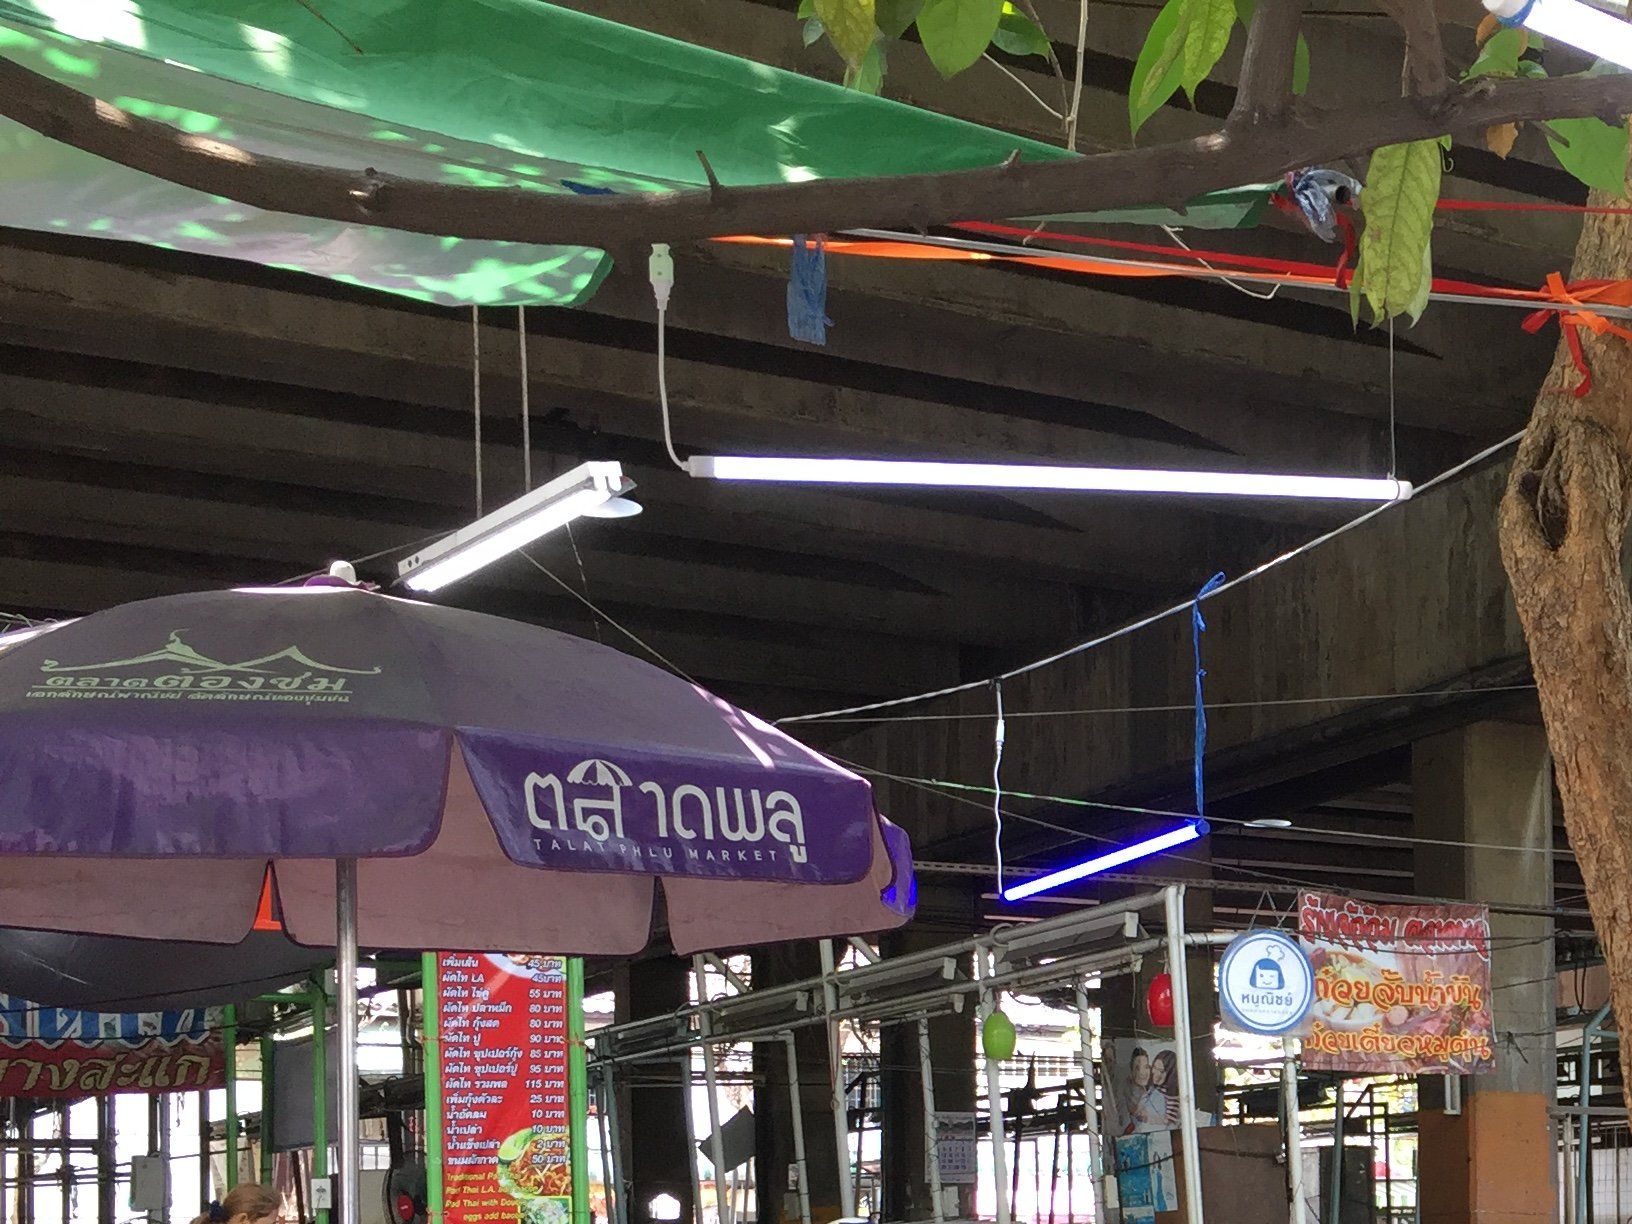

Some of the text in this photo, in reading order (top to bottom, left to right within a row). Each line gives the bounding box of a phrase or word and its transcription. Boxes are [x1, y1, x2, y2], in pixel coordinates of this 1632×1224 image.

[524, 759, 807, 863] ตลาดพลู
[534, 838, 778, 862] TALAT PHLU MARKET
[543, 960, 562, 968] บาท
[442, 971, 468, 982] ผัดไท
[442, 986, 468, 998] ผัดไท
[529, 989, 562, 998] 55 บาท
[443, 1001, 469, 1013] ผัดไท
[543, 1005, 562, 1013] บาท
[443, 1017, 469, 1028] ผัดไท
[543, 1020, 563, 1028] บาท
[444, 1047, 470, 1058] ผัดไท
[544, 1050, 563, 1058] บาท
[445, 1062, 471, 1073] ผัดไท
[544, 1065, 564, 1073] บาท
[445, 1077, 471, 1088] ผัดไท
[525, 1080, 564, 1088] 115 บาท
[530, 1095, 564, 1103] 25 บาท
[532, 1110, 565, 1118] 10 บาท
[545, 1125, 565, 1133] บาท
[545, 1140, 565, 1148] บาท
[546, 1155, 566, 1164] บาท
[463, 1199, 479, 1207] Thai
